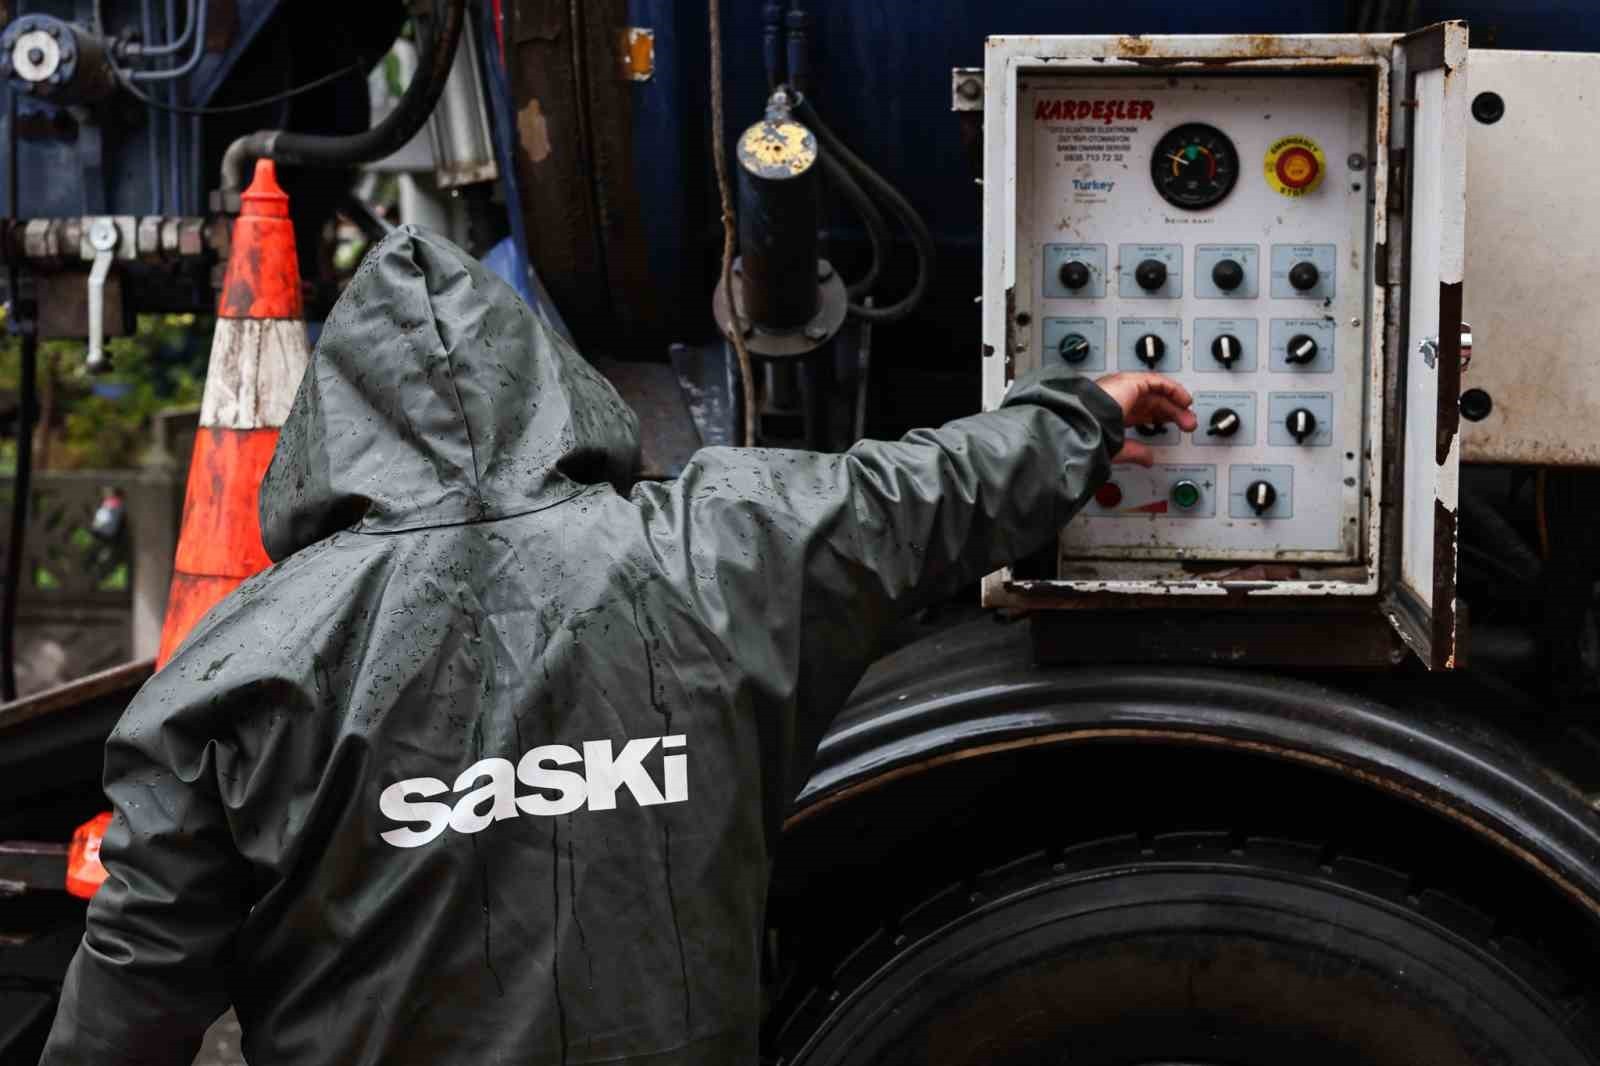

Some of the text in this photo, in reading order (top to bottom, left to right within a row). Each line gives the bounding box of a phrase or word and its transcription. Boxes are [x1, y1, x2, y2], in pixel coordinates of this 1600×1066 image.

[1034, 99, 1155, 124] KARDEŞLER
[1271, 137, 1318, 154] EMERGENCY
[1072, 179, 1115, 192] Turkey
